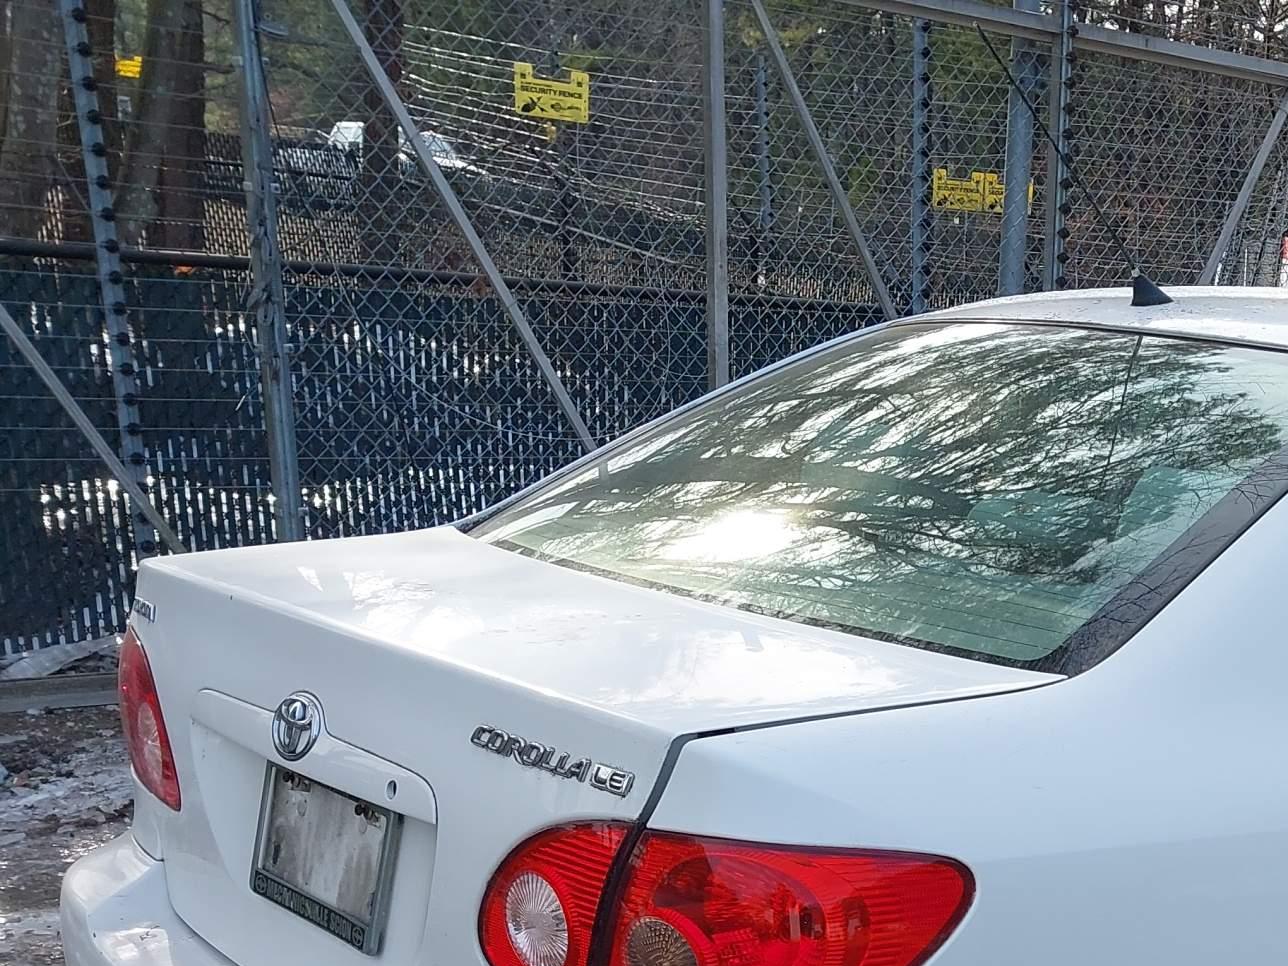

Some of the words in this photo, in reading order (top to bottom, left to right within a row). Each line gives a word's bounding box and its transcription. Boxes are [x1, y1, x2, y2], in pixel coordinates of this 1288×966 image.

[520, 85, 558, 96] SECURITY
[558, 90, 583, 100] FENCE
[470, 724, 592, 783] COROLLA
[591, 764, 632, 796] LE
